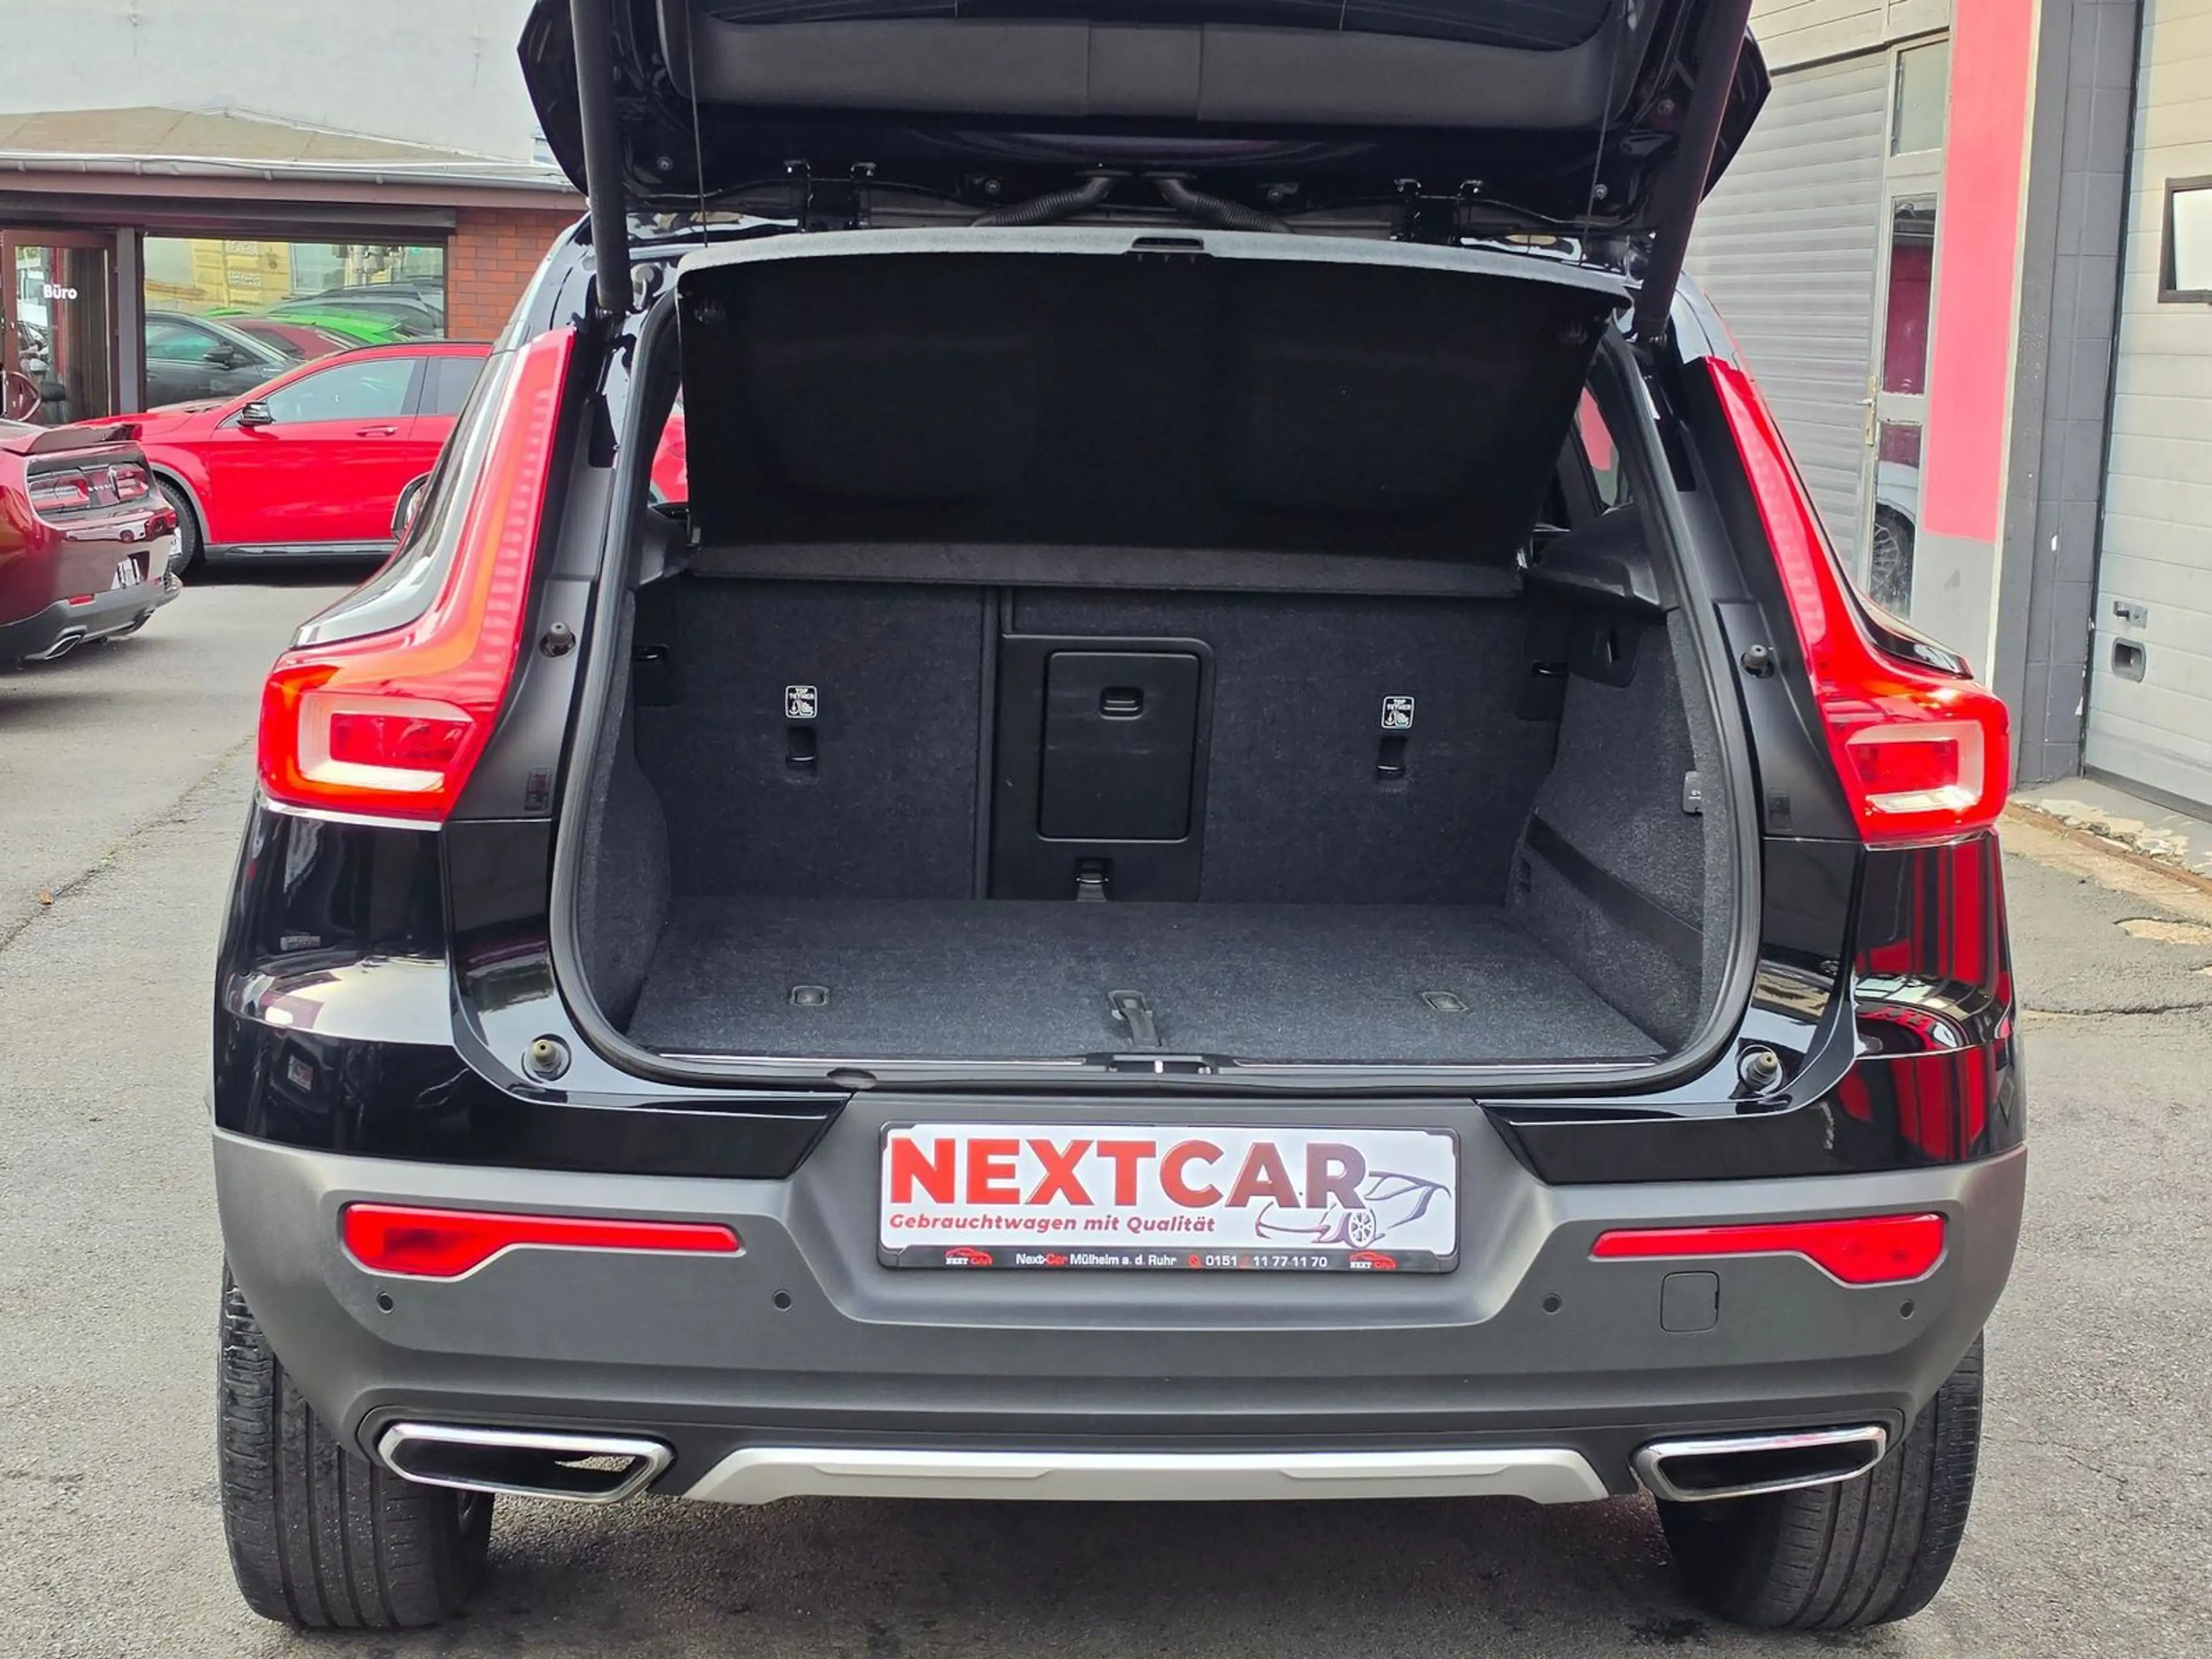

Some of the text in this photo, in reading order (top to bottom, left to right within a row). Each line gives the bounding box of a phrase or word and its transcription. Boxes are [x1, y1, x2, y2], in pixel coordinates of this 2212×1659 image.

[43, 283, 77, 299] Büro
[890, 1138, 1366, 1209] NEXTCAR
[889, 1214, 1215, 1234] Gebrauchtwagen mit Qualität
[1070, 1253, 1119, 1265] Mülheim
[1122, 1257, 1132, 1265] a.
[1135, 1254, 1146, 1265] d.
[1148, 1254, 1177, 1266] Ruhr
[1205, 1255, 1237, 1266] 0151
[1253, 1256, 1267, 1266] 11
[1272, 1256, 1288, 1267] 77
[1293, 1256, 1306, 1267] 11
[1311, 1256, 1328, 1267] 70
